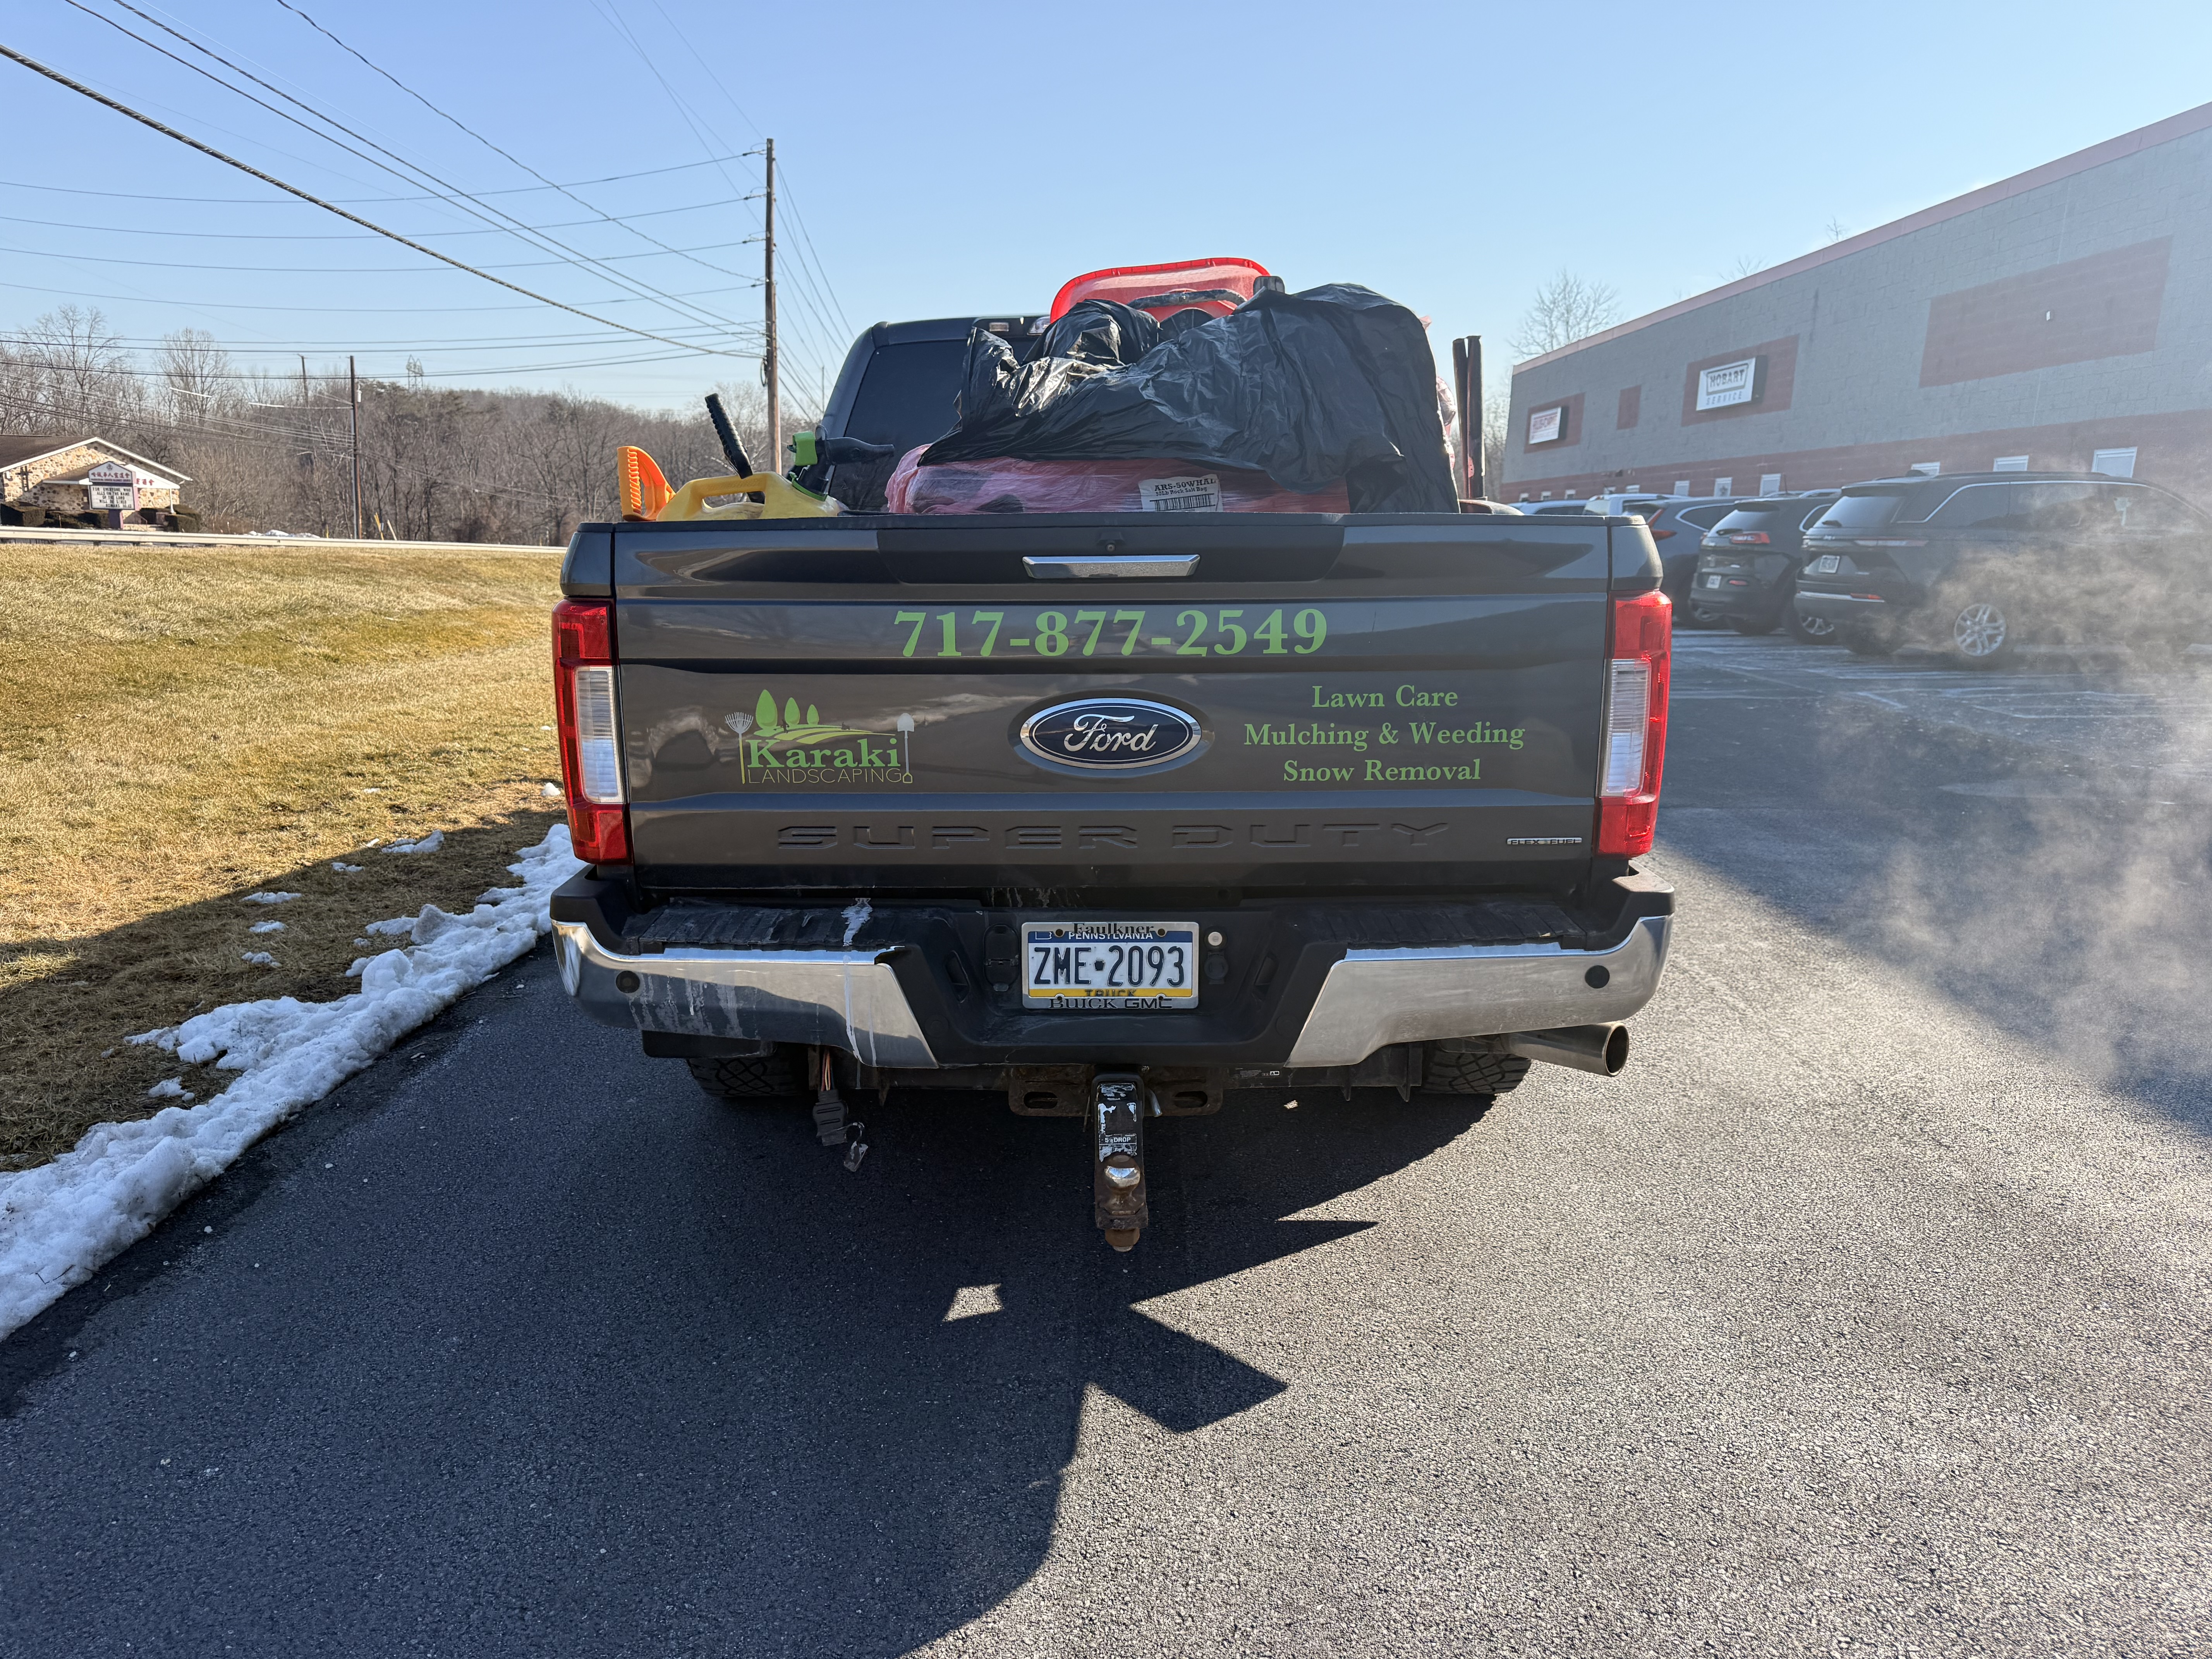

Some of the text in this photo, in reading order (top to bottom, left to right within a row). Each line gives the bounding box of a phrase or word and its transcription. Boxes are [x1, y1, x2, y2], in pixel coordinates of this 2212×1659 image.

[1710, 369, 1745, 387] HOBART
[1706, 391, 1742, 405] SERVICE
[894, 609, 1327, 657] 717-877-2549
[1312, 684, 1458, 708] Lawn Care
[1064, 714, 1159, 752] Ford
[1244, 721, 1525, 752] Mulching & Weeding
[745, 738, 901, 768] Karaki
[748, 768, 902, 783] LANDSCAPING
[1284, 759, 1481, 781] Snow Removal
[778, 823, 1449, 849] SUPER DUTY
[1068, 931, 1153, 940] PENNSYLVANIA
[1072, 922, 1154, 934] Faulkner
[1034, 945, 1184, 987] ZME 2093
[1049, 998, 1173, 1009] BUICK GMC
[1085, 989, 1136, 997] TRUCK
